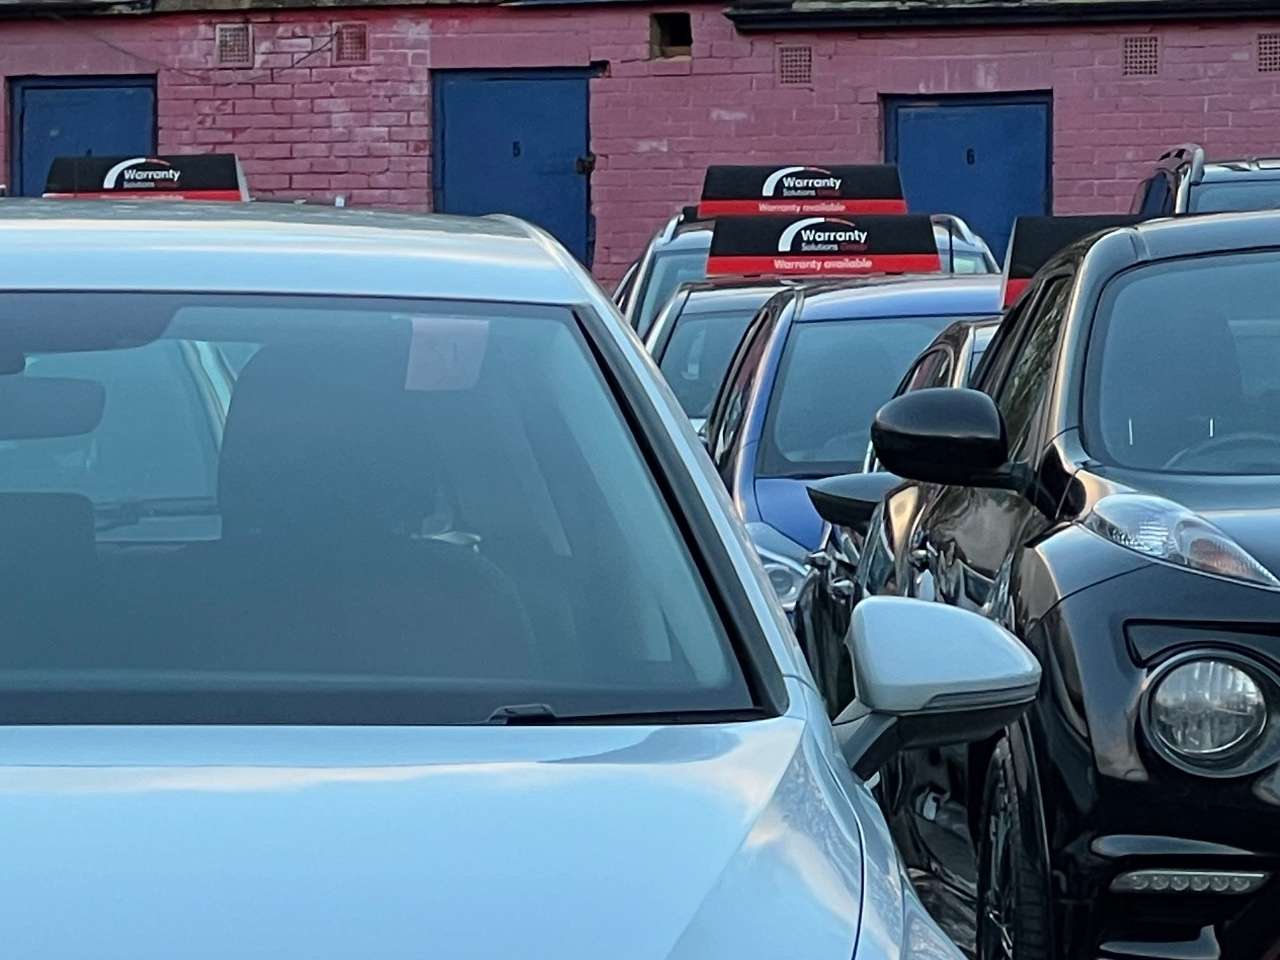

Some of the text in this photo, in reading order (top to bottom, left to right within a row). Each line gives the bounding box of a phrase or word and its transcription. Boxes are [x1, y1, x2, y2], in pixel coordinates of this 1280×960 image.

[512, 141, 521, 158] 5
[966, 148, 975, 166] 6
[124, 169, 180, 182] Warranty
[783, 177, 841, 190] Warranty
[783, 188, 816, 197] Solutions
[758, 202, 846, 213] Warranty available
[801, 229, 867, 243] Warranty
[801, 242, 838, 251] Solutions
[773, 257, 872, 271] Warranty available
